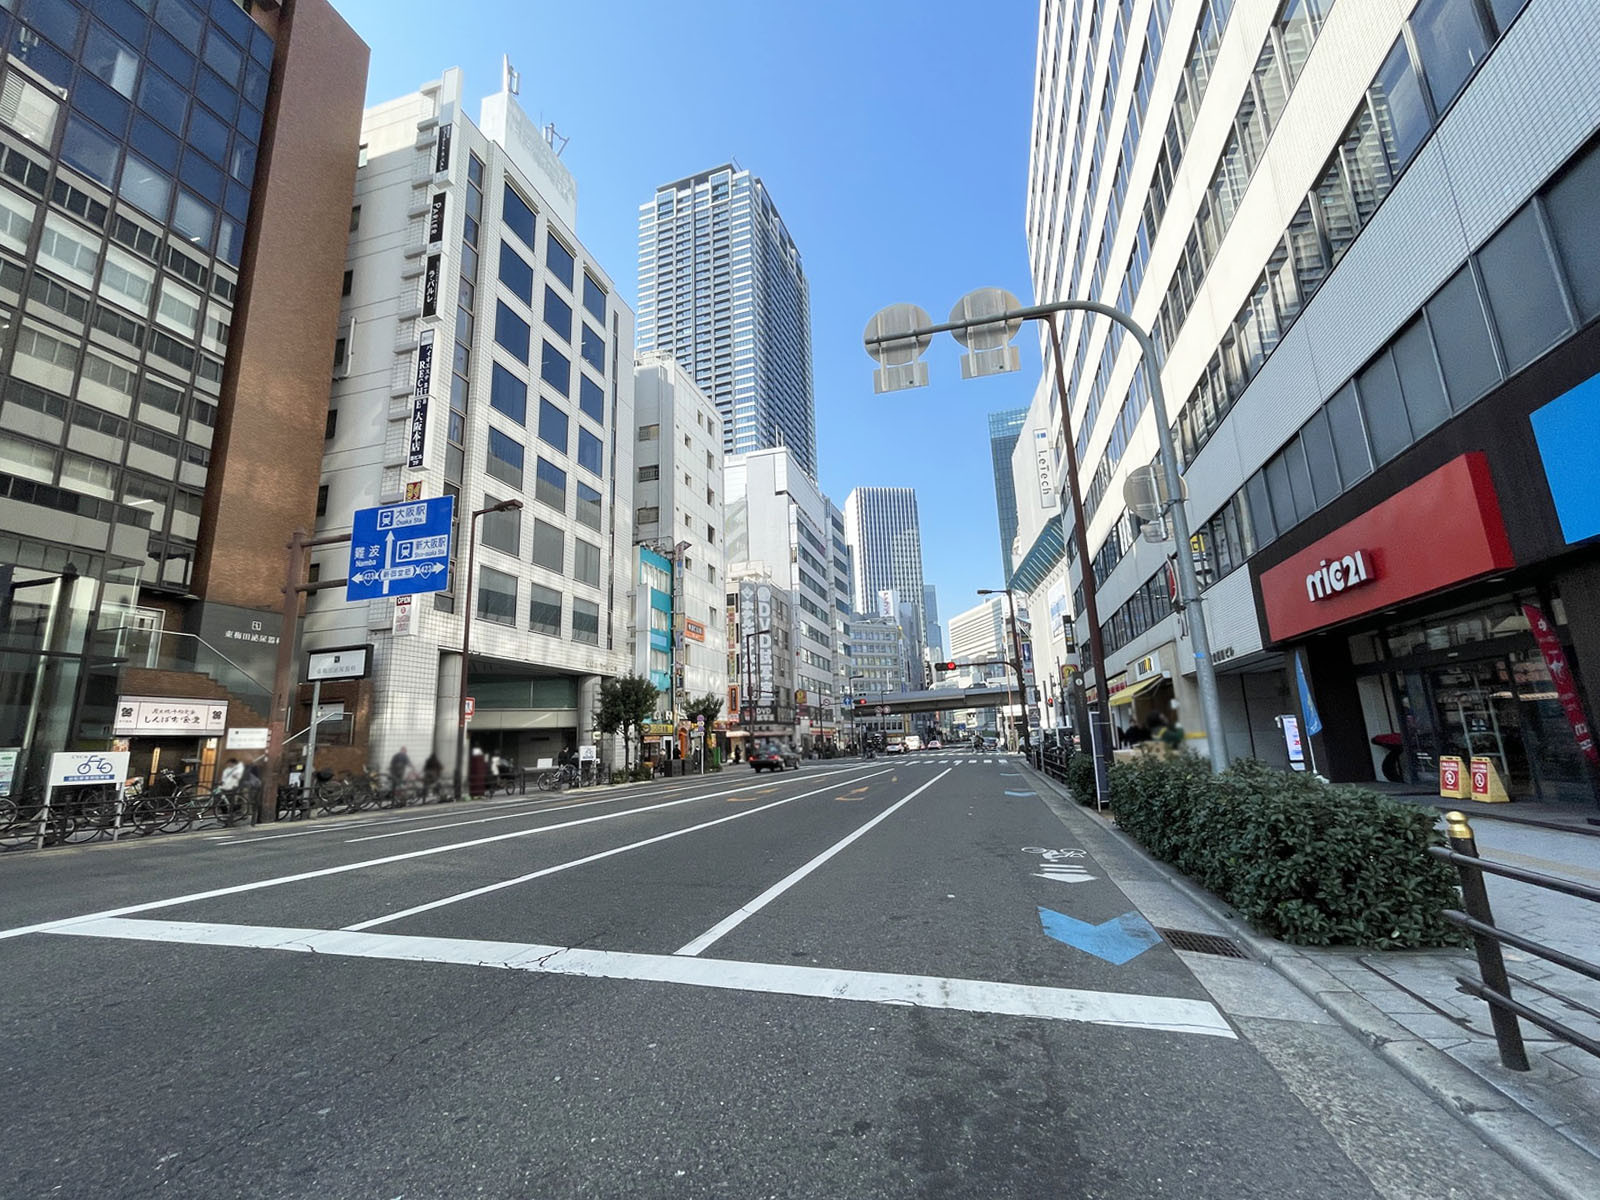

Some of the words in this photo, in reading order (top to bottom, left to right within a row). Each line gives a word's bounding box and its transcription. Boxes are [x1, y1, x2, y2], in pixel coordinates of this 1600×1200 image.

[415, 360, 426, 409] RECHE
[1037, 450, 1052, 495] LeTech
[395, 505, 426, 519] 大阪駅
[415, 537, 446, 550] 新大阪駅
[1306, 550, 1367, 602] mic21
